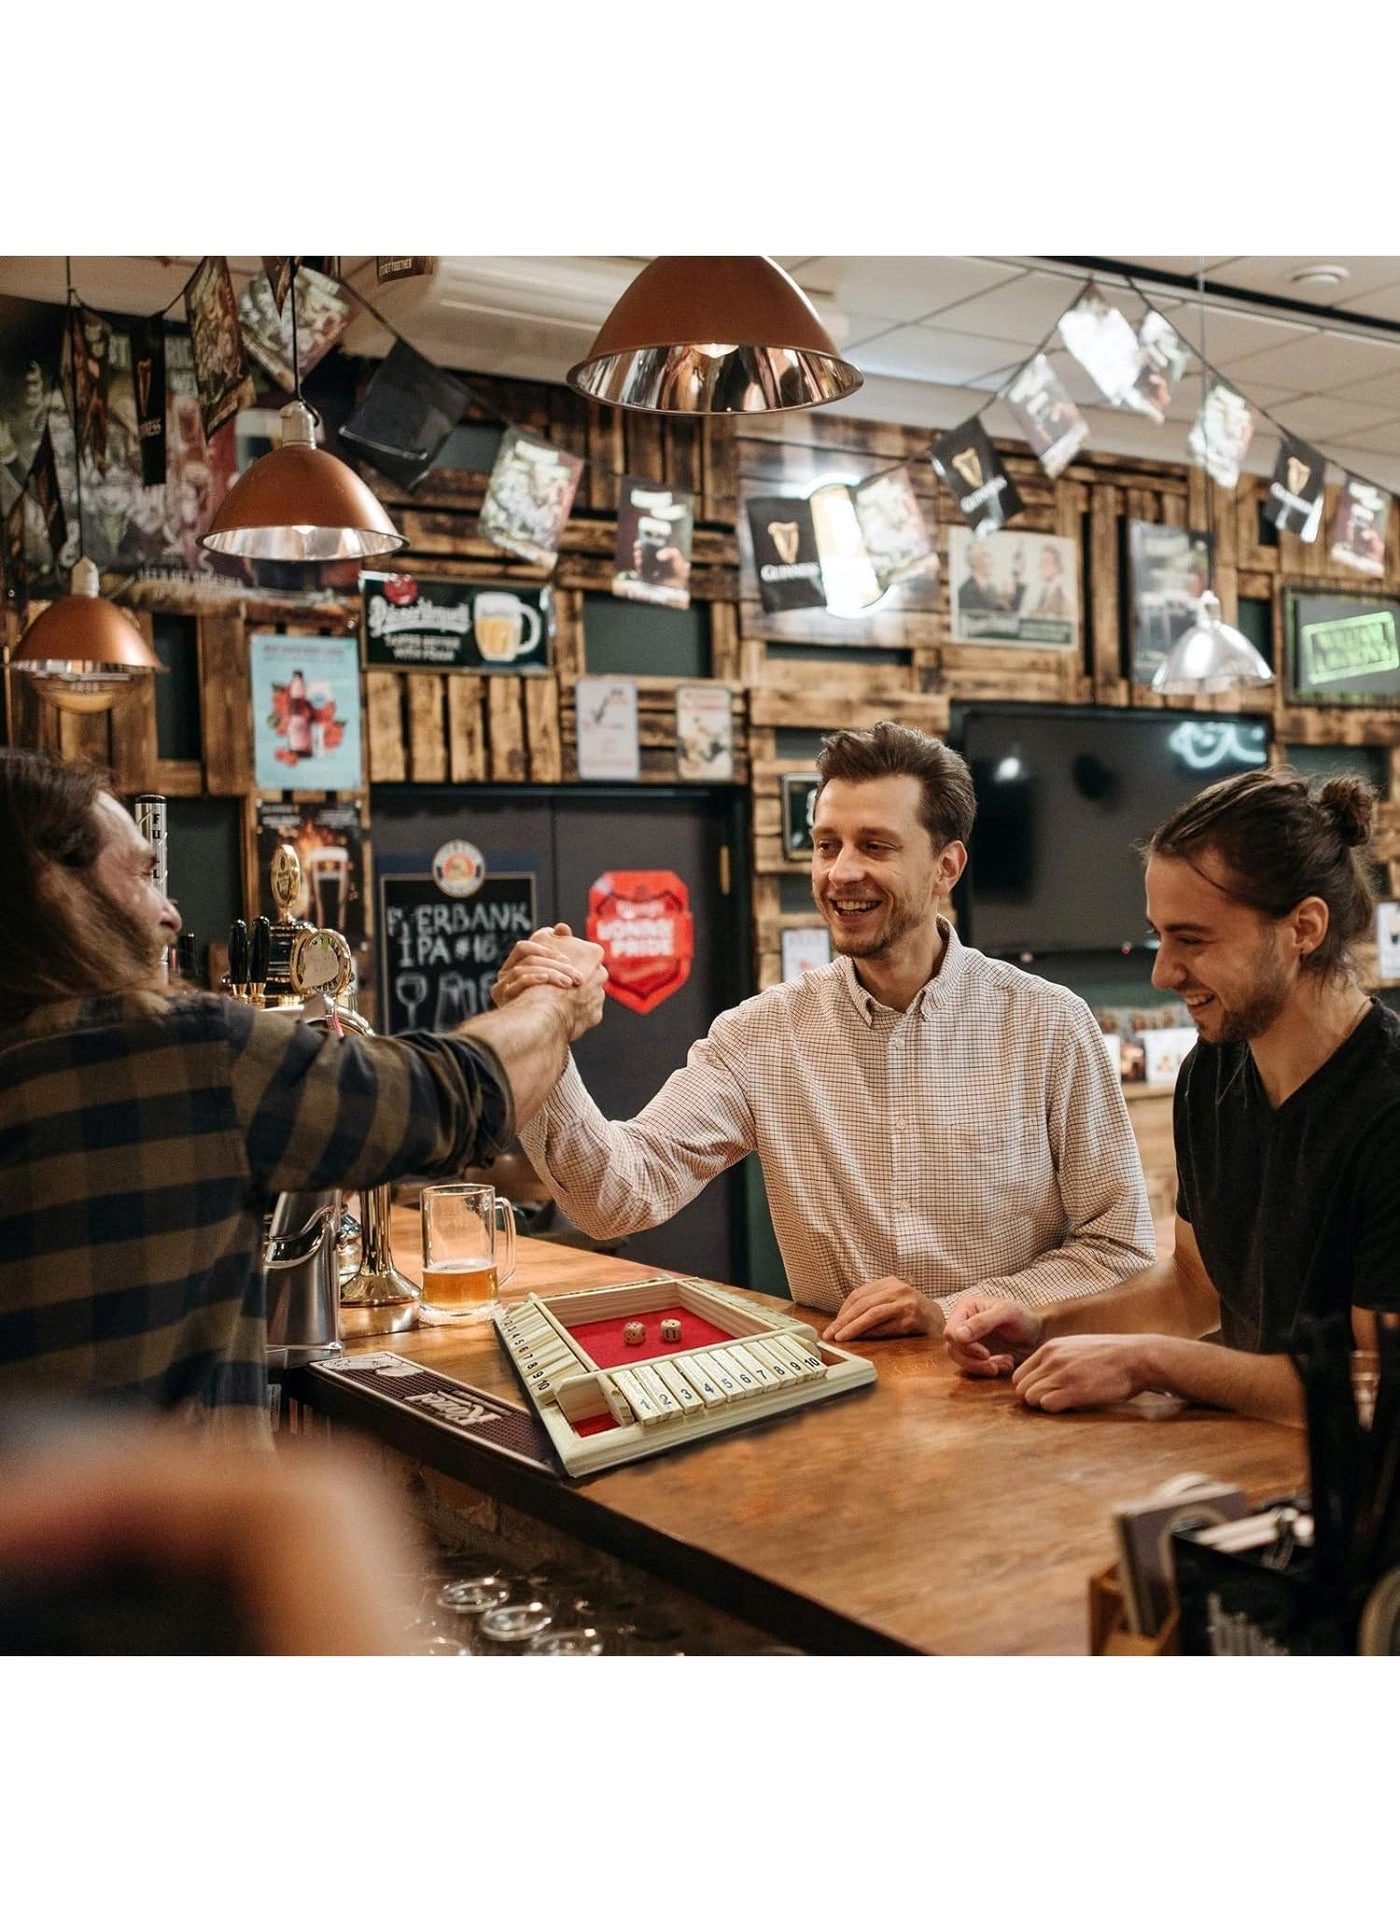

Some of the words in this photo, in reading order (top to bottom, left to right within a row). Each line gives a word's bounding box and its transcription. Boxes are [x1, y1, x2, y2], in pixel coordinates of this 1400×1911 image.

[398, 933, 452, 968] IPA
[610, 938, 674, 957] PRIDE
[527, 1361, 538, 1370] 8
[533, 1371, 544, 1379] 9
[537, 1380, 550, 1391] 10
[640, 1398, 651, 1410] 1
[659, 1394, 672, 1406] 2
[680, 1388, 692, 1400] 3
[704, 1383, 714, 1394] 4
[721, 1378, 733, 1389] 5
[739, 1373, 751, 1384] 6
[756, 1369, 767, 1380] 7
[773, 1365, 785, 1376] 8
[789, 1361, 801, 1371] 9
[804, 1356, 821, 1369] 10
